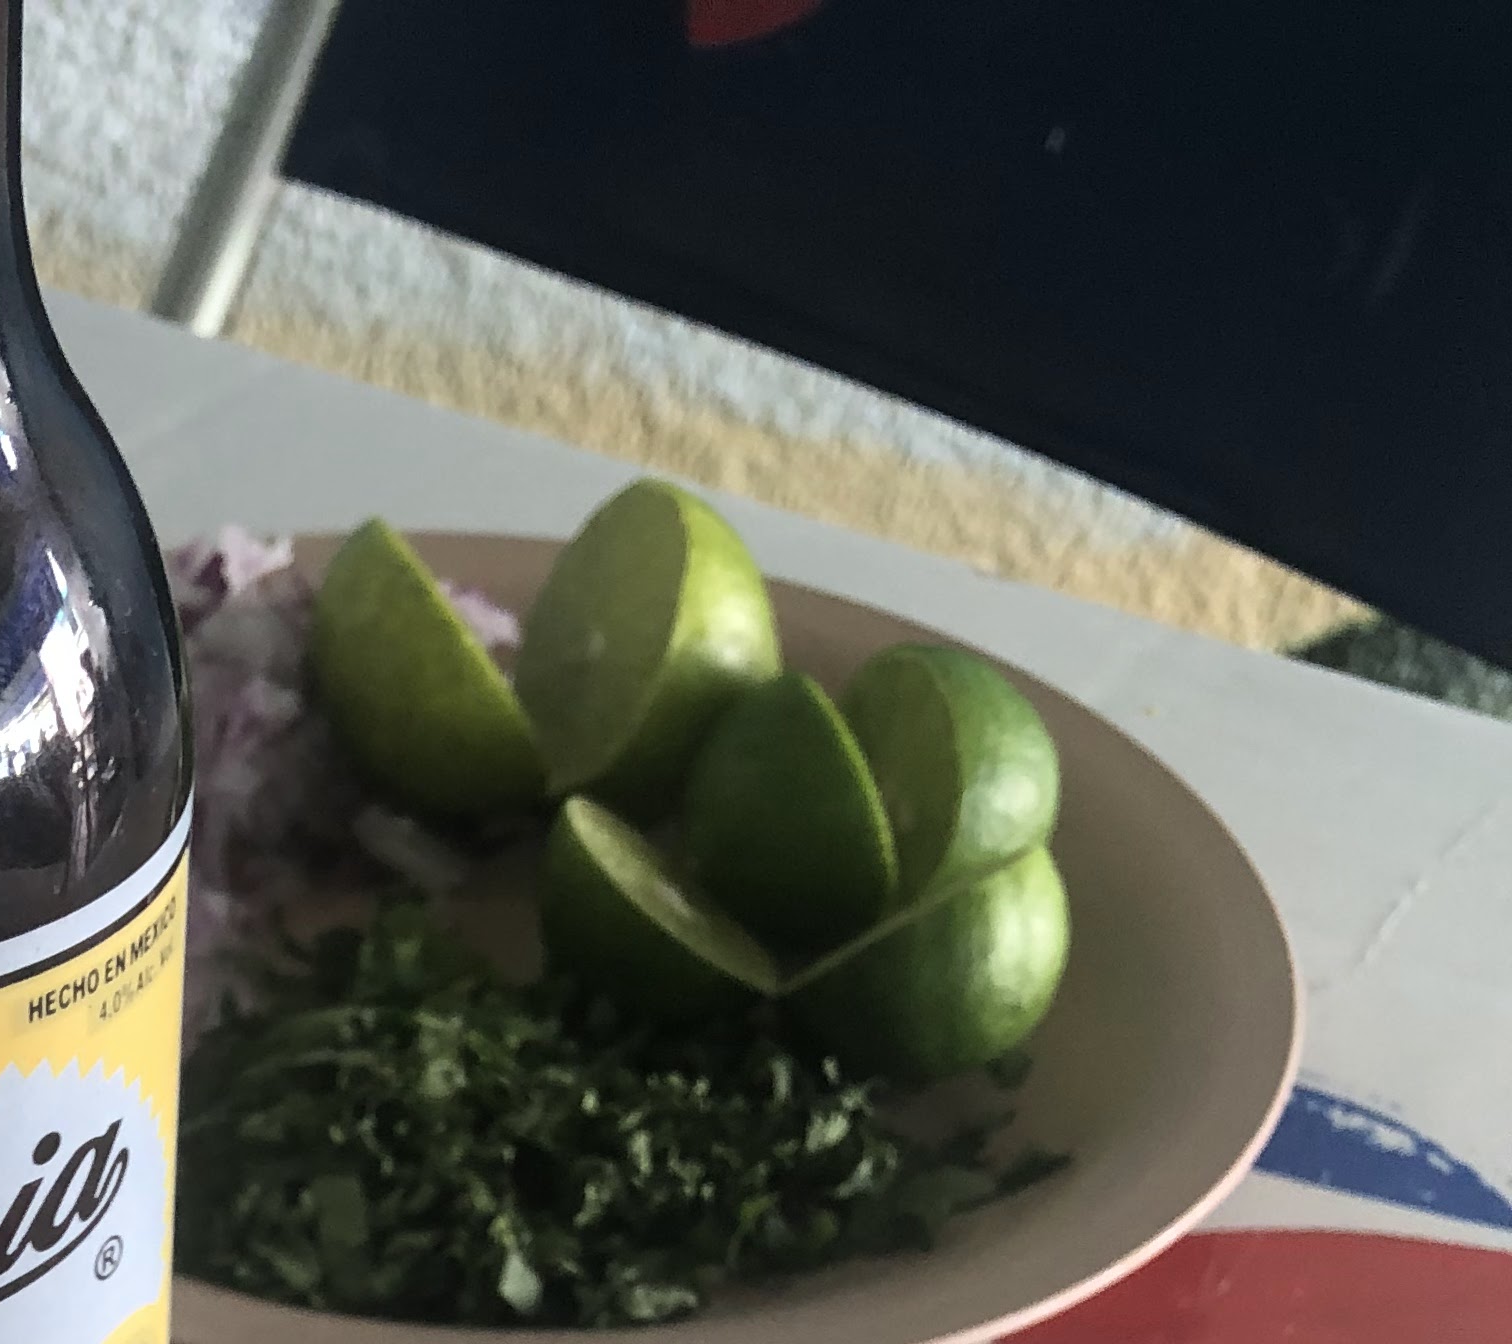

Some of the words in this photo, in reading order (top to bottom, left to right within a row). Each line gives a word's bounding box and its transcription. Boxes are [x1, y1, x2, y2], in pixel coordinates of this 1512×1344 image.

[28, 967, 100, 1023] HECHO
[104, 948, 127, 985] EN
[129, 896, 177, 966] MEXICO
